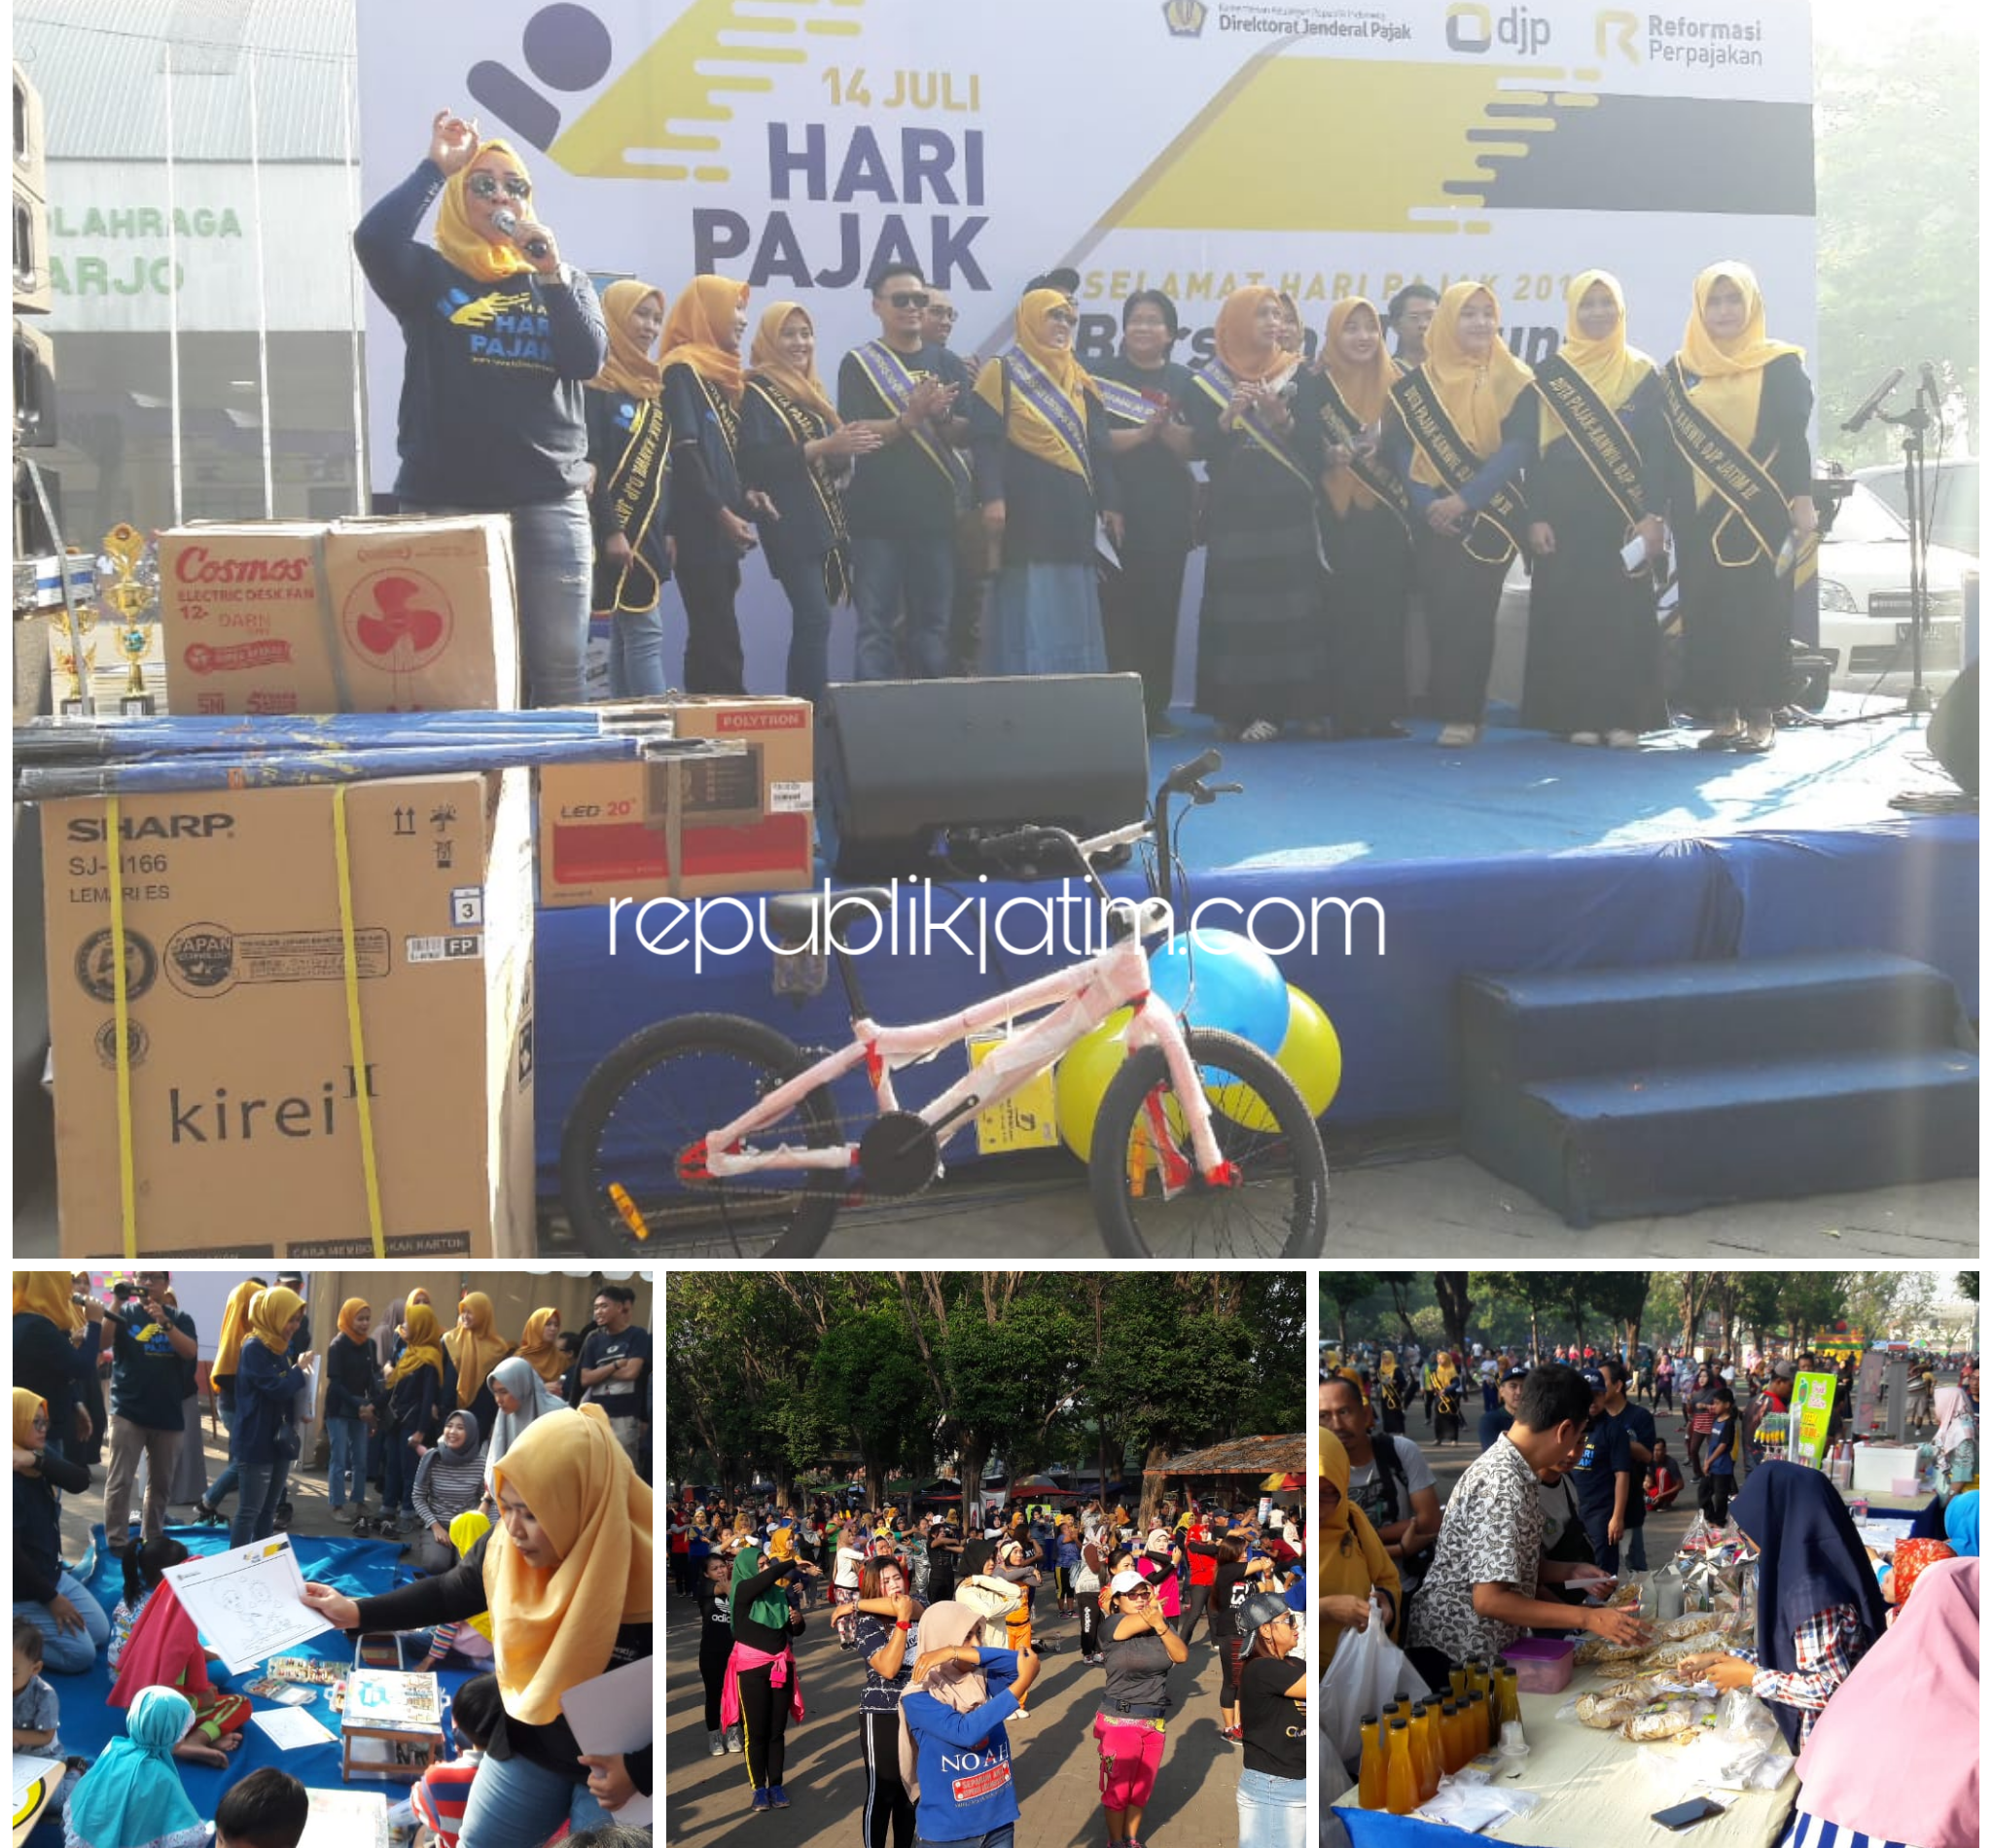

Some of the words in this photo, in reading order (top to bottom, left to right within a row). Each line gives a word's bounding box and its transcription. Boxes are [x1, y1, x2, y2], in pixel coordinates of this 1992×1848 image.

[1219, 15, 1300, 34] Direktorat
[1301, 18, 1368, 38] Jenderal
[1370, 22, 1412, 42] Pajak
[1497, 7, 1550, 54] djp
[1649, 14, 1761, 42] Reformasi
[1650, 40, 1762, 67] Perpajakan
[822, 67, 872, 107] 14
[882, 70, 980, 112] JULI
[767, 122, 984, 206] HARI
[48, 205, 243, 239] LAHRAGA
[693, 207, 992, 291] PAJAK
[1083, 270, 1265, 300] SELAMAT
[1280, 272, 1370, 302] HARI
[495, 314, 551, 337] HAR
[176, 546, 308, 584] Cosmos
[177, 589, 242, 602] ELECTRIC
[286, 587, 315, 599] FAN
[723, 714, 800, 728] POLYTRON
[560, 804, 601, 819] LED
[67, 813, 235, 842] SHARP
[69, 854, 168, 876] SJ-166
[70, 887, 140, 904] LEMRI
[146, 885, 170, 901] ES
[462, 903, 474, 919] 3
[449, 940, 473, 954] FP
[170, 1082, 335, 1144] kirei
